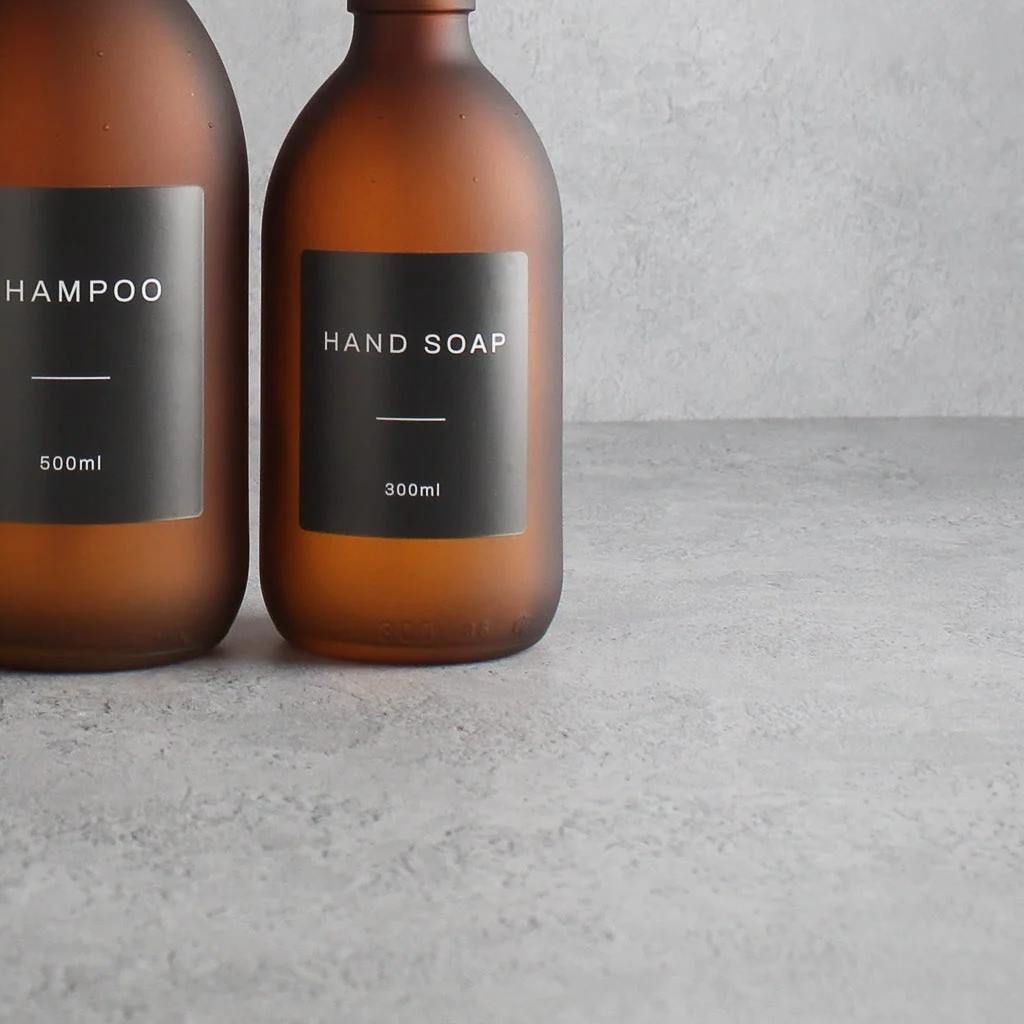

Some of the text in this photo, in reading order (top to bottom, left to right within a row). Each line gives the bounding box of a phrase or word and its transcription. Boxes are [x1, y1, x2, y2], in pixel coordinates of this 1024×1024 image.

[323, 330, 506, 355] HAND SOAP
[38, 454, 102, 471] 500ml
[383, 481, 441, 497] 300ml
